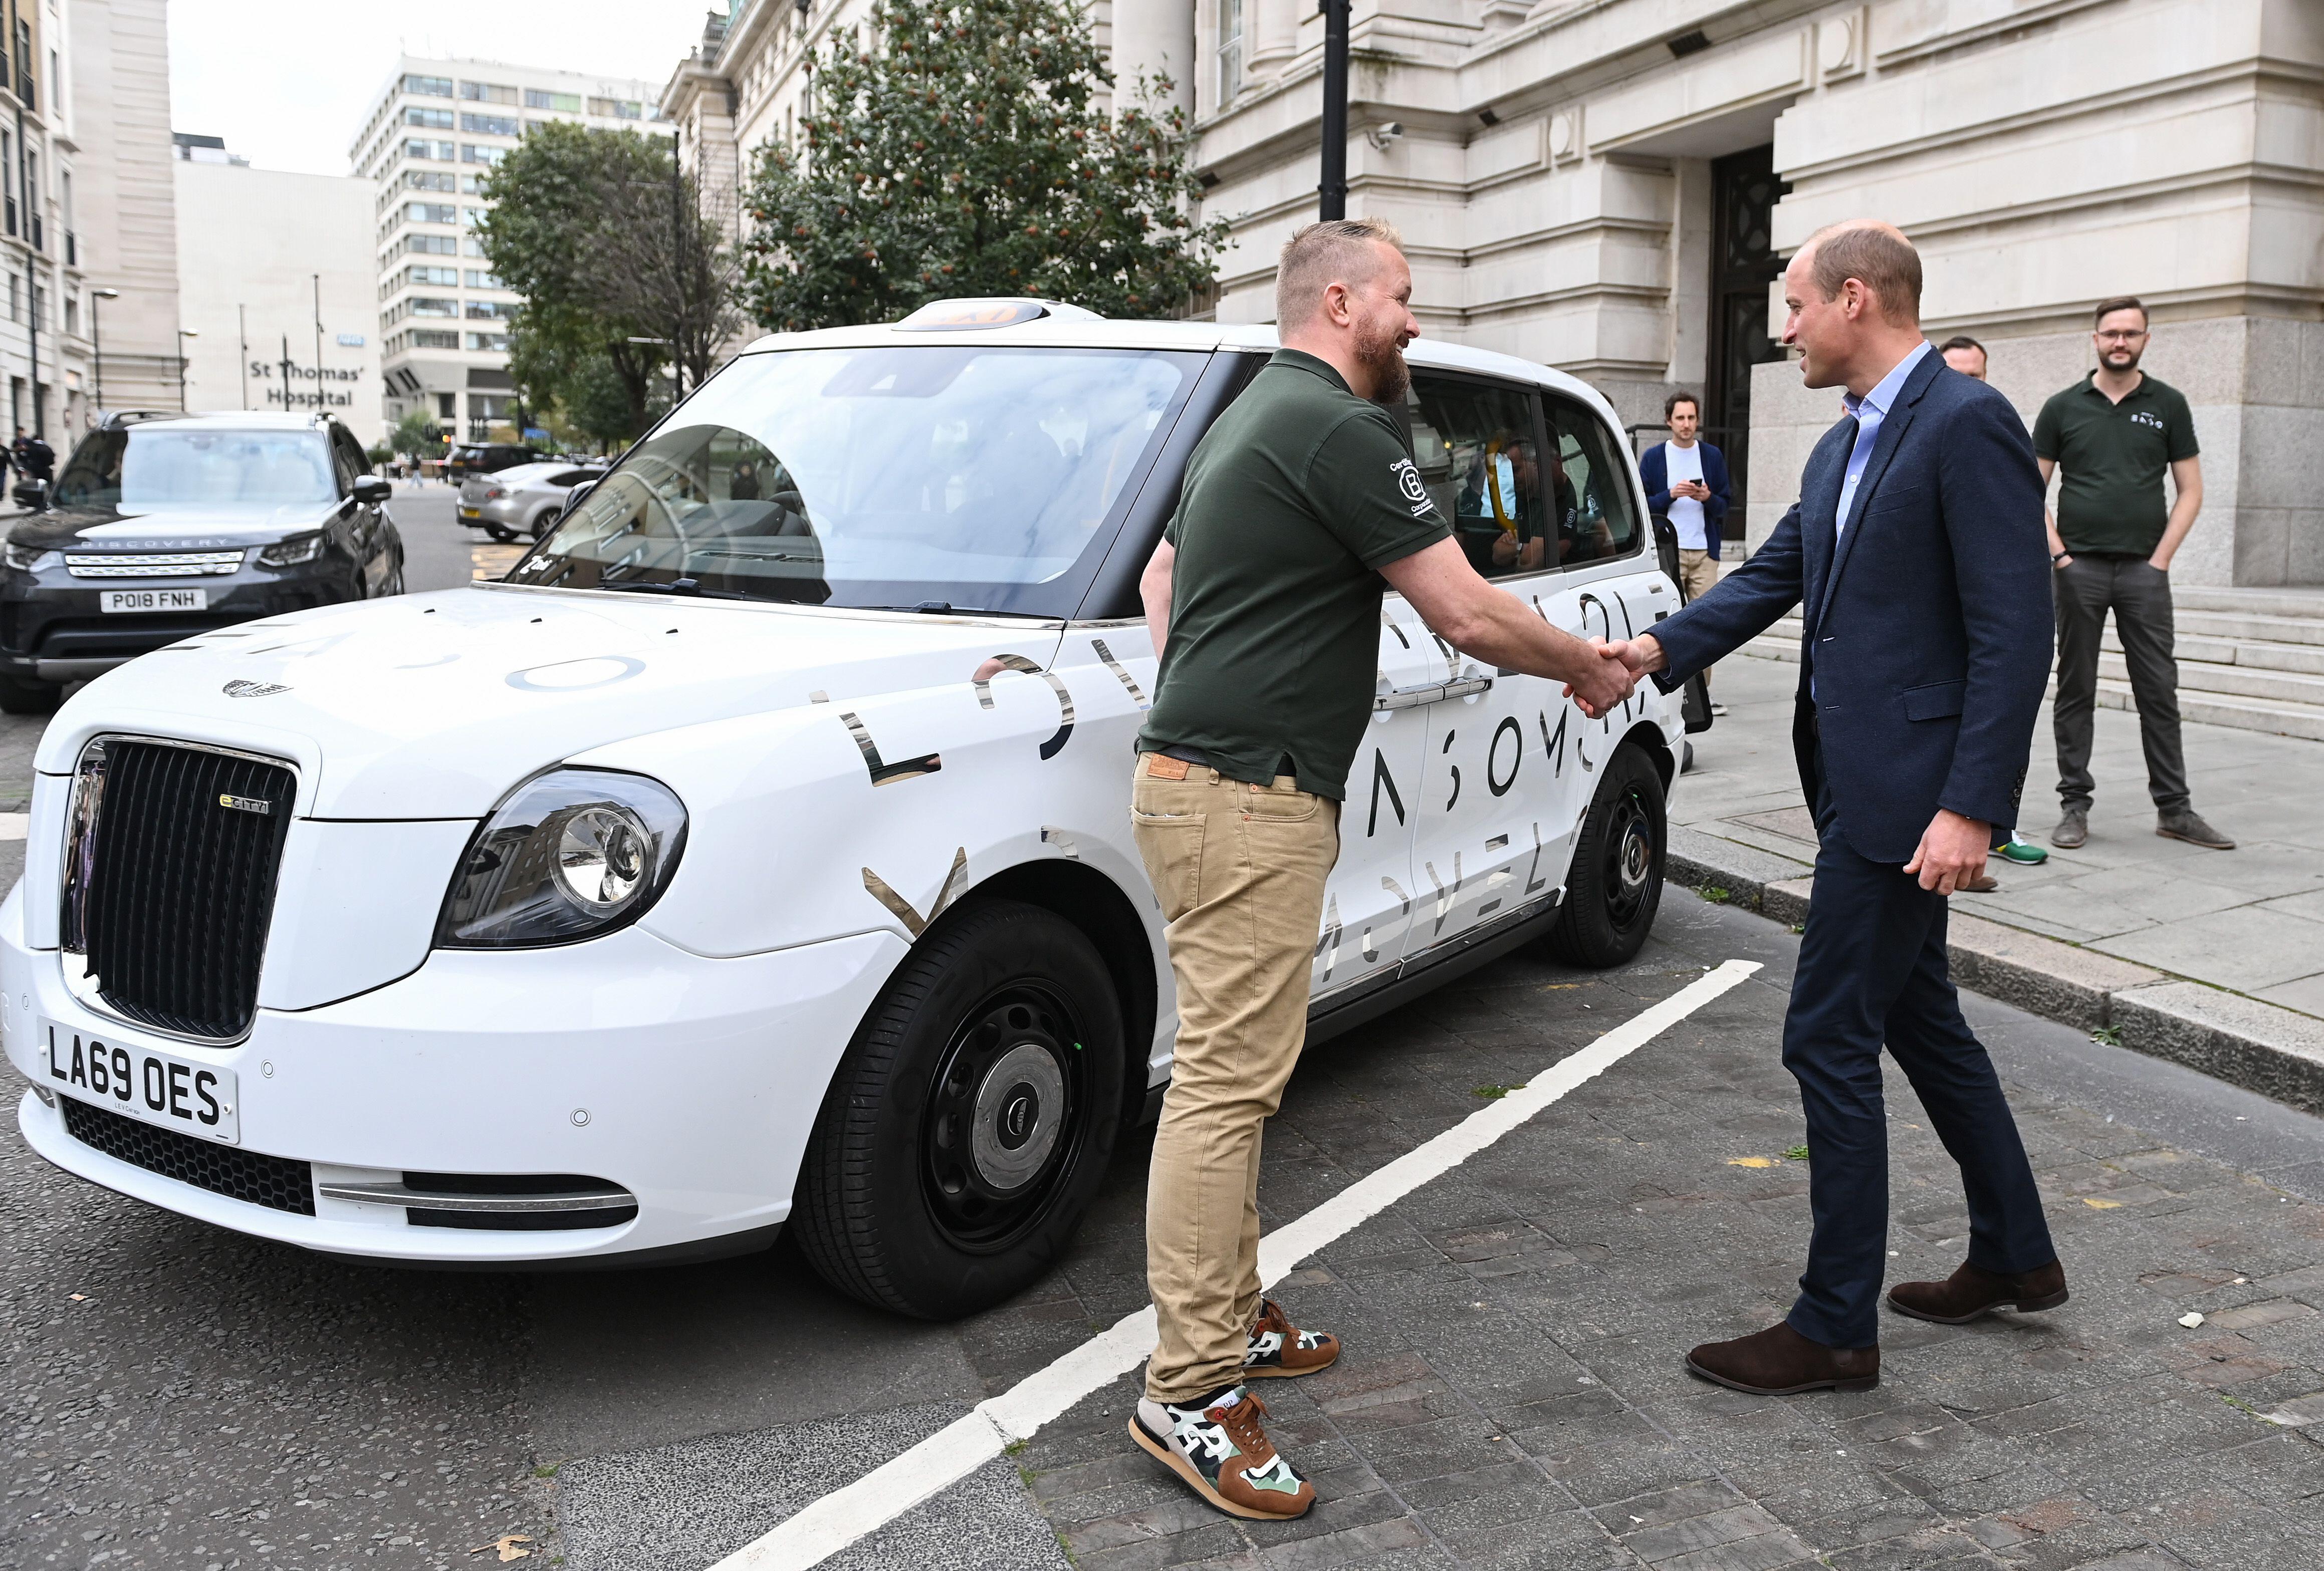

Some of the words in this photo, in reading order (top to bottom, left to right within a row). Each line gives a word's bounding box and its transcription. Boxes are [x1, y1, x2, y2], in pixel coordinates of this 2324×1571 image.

[251, 361, 270, 377] St
[267, 387, 352, 407] Hospital
[81, 539, 227, 550] DISCOVERY
[113, 593, 153, 608] PO18
[158, 592, 194, 607] FNH
[49, 1025, 132, 1102] LA69
[143, 1057, 219, 1126] OES
